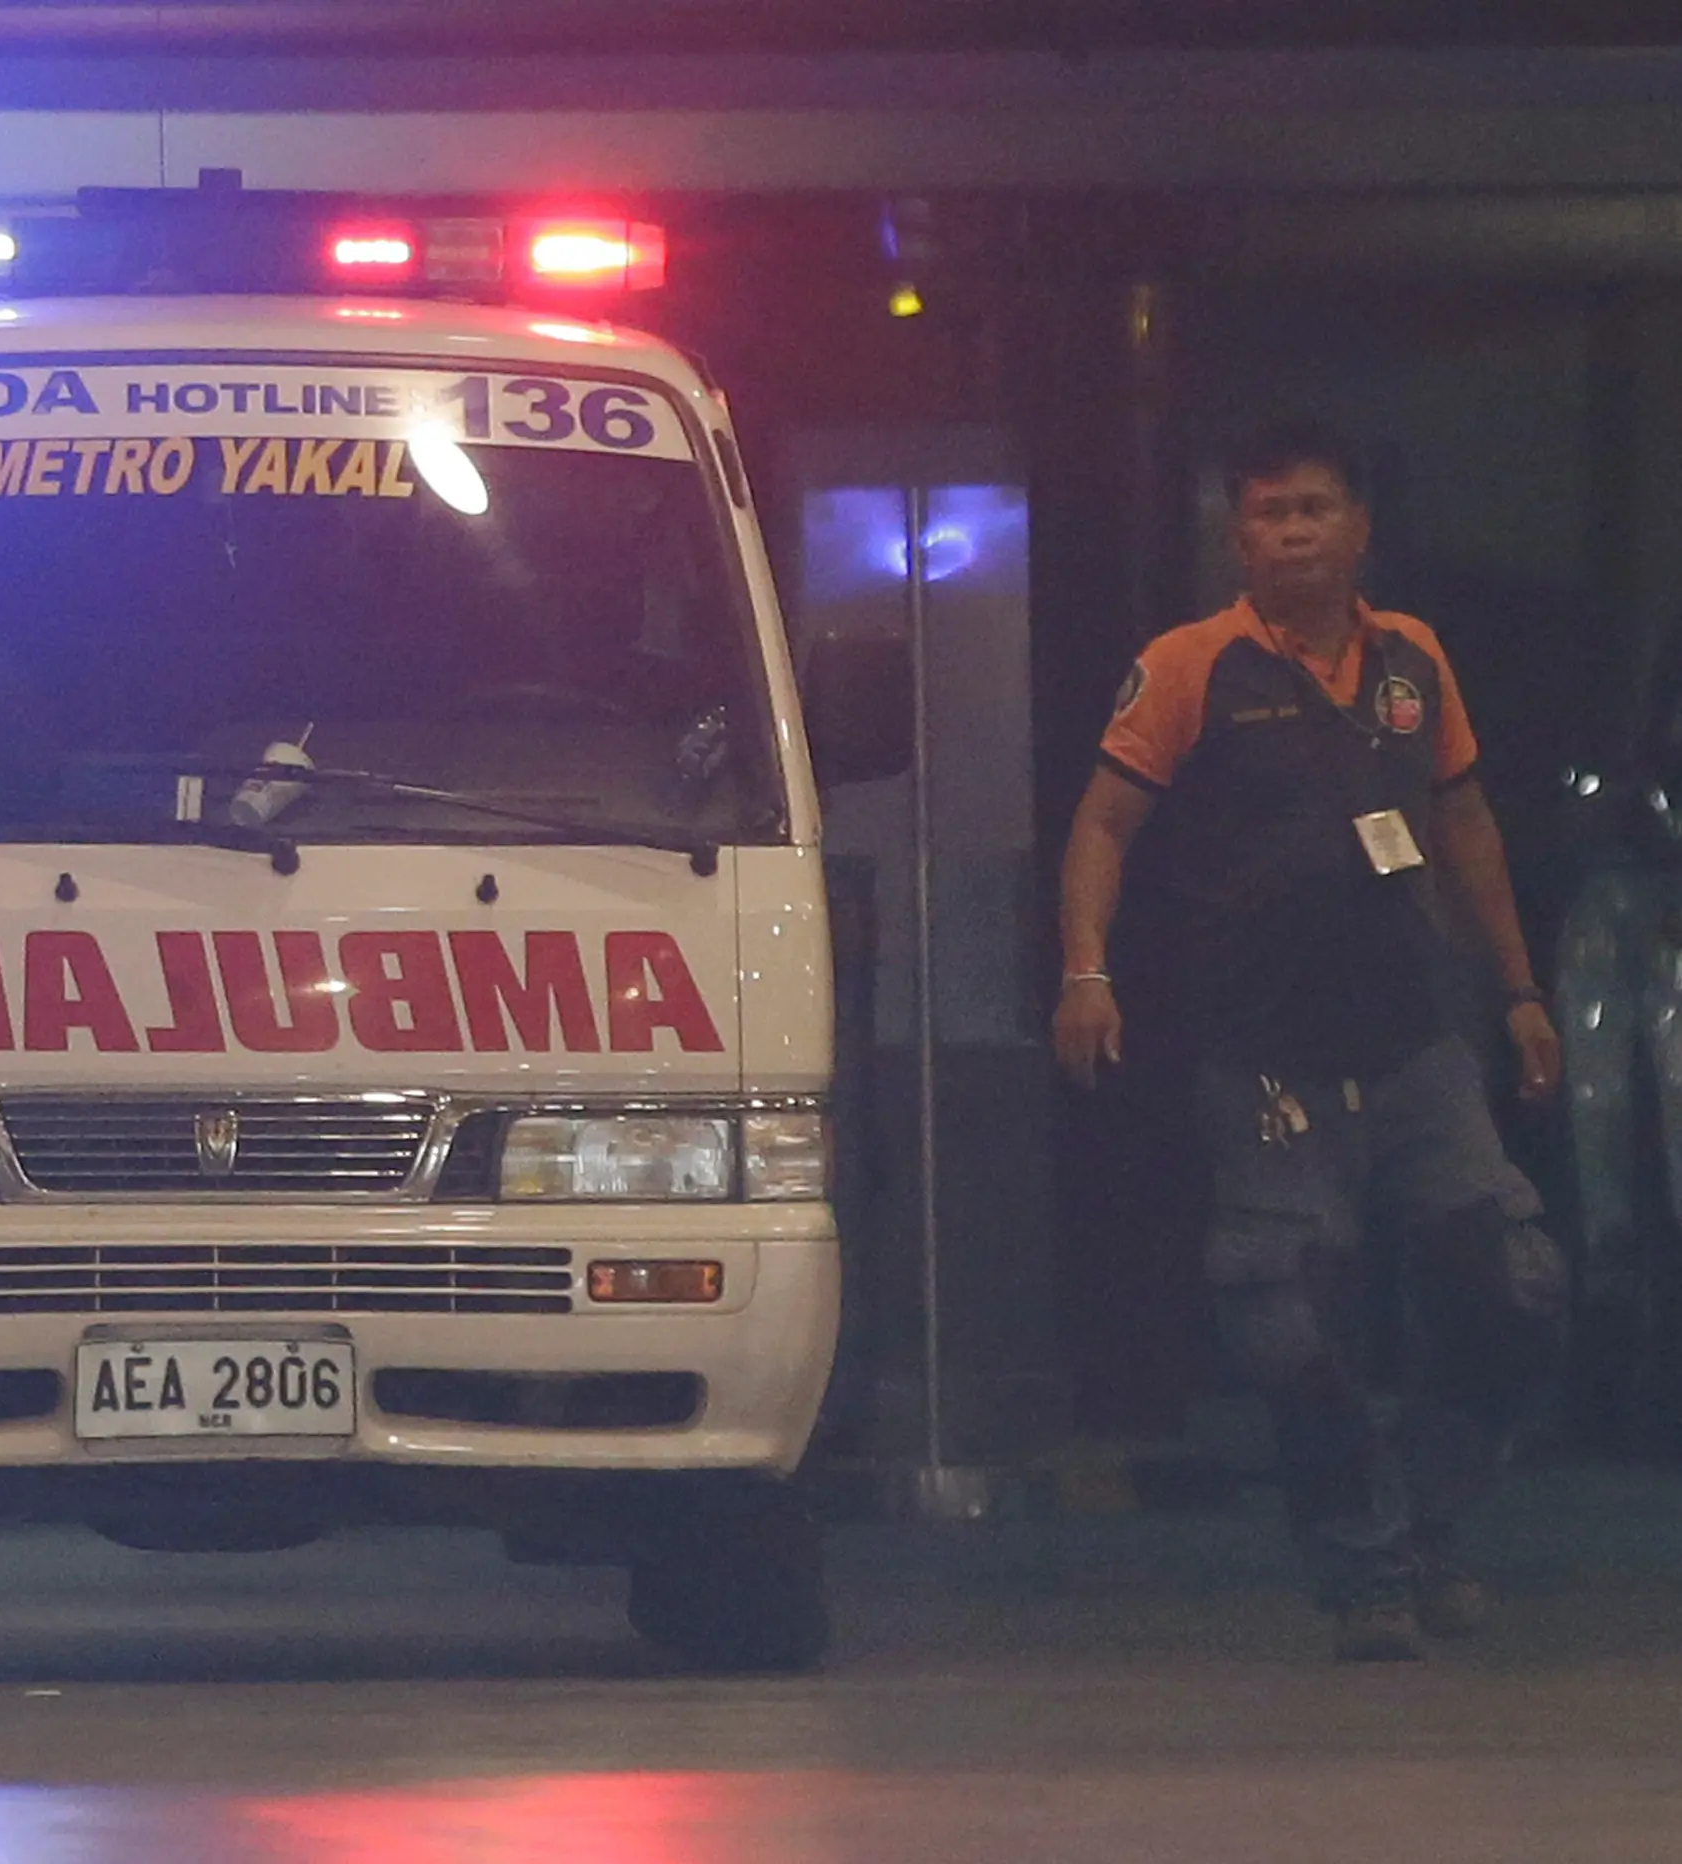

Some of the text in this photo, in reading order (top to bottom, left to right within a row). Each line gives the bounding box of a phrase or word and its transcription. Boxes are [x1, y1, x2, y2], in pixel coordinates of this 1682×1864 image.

[440, 375, 656, 450] 136
[220, 438, 415, 498] YAKAL
[92, 1355, 341, 1413] AEA 2806
